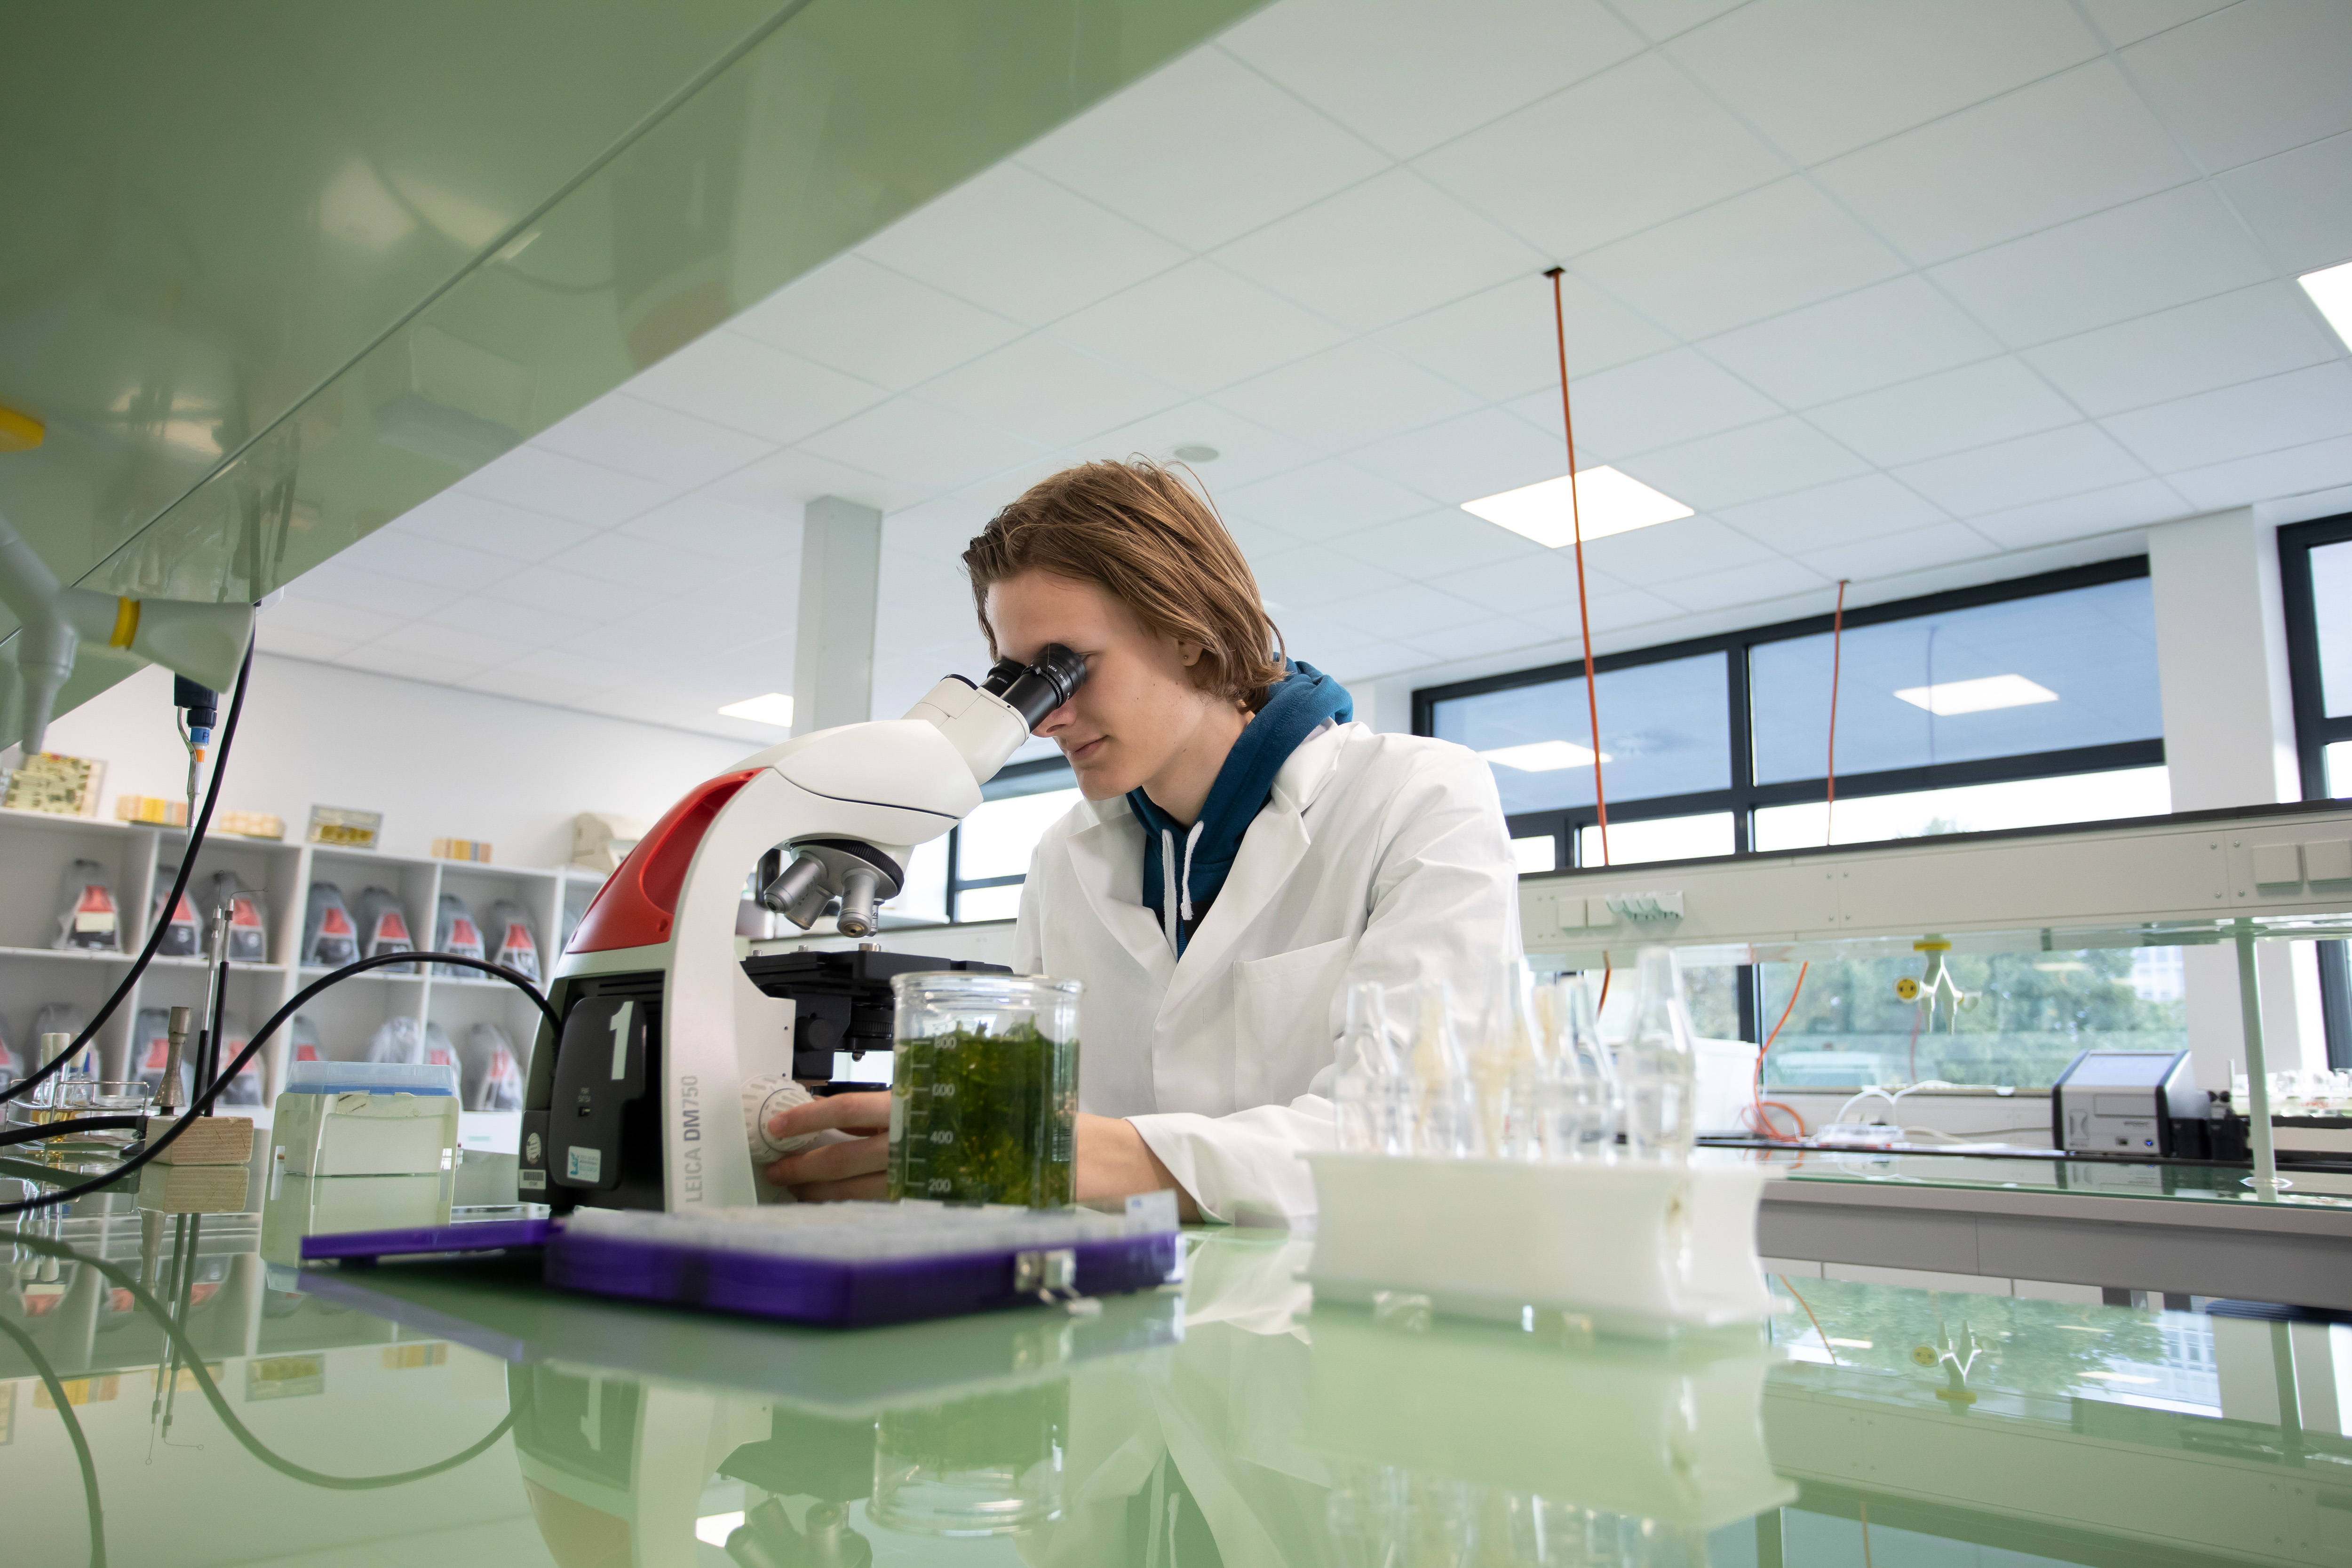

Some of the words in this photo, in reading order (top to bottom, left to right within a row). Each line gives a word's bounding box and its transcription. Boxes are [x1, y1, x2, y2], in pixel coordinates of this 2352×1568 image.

[609, 1001, 634, 1080] 1
[934, 1036, 957, 1049] 800
[932, 1082, 955, 1097] 600
[681, 1075, 700, 1141] DM750
[930, 1130, 954, 1144] 400
[684, 1147, 703, 1203] LEICA
[928, 1178, 952, 1193] 200
